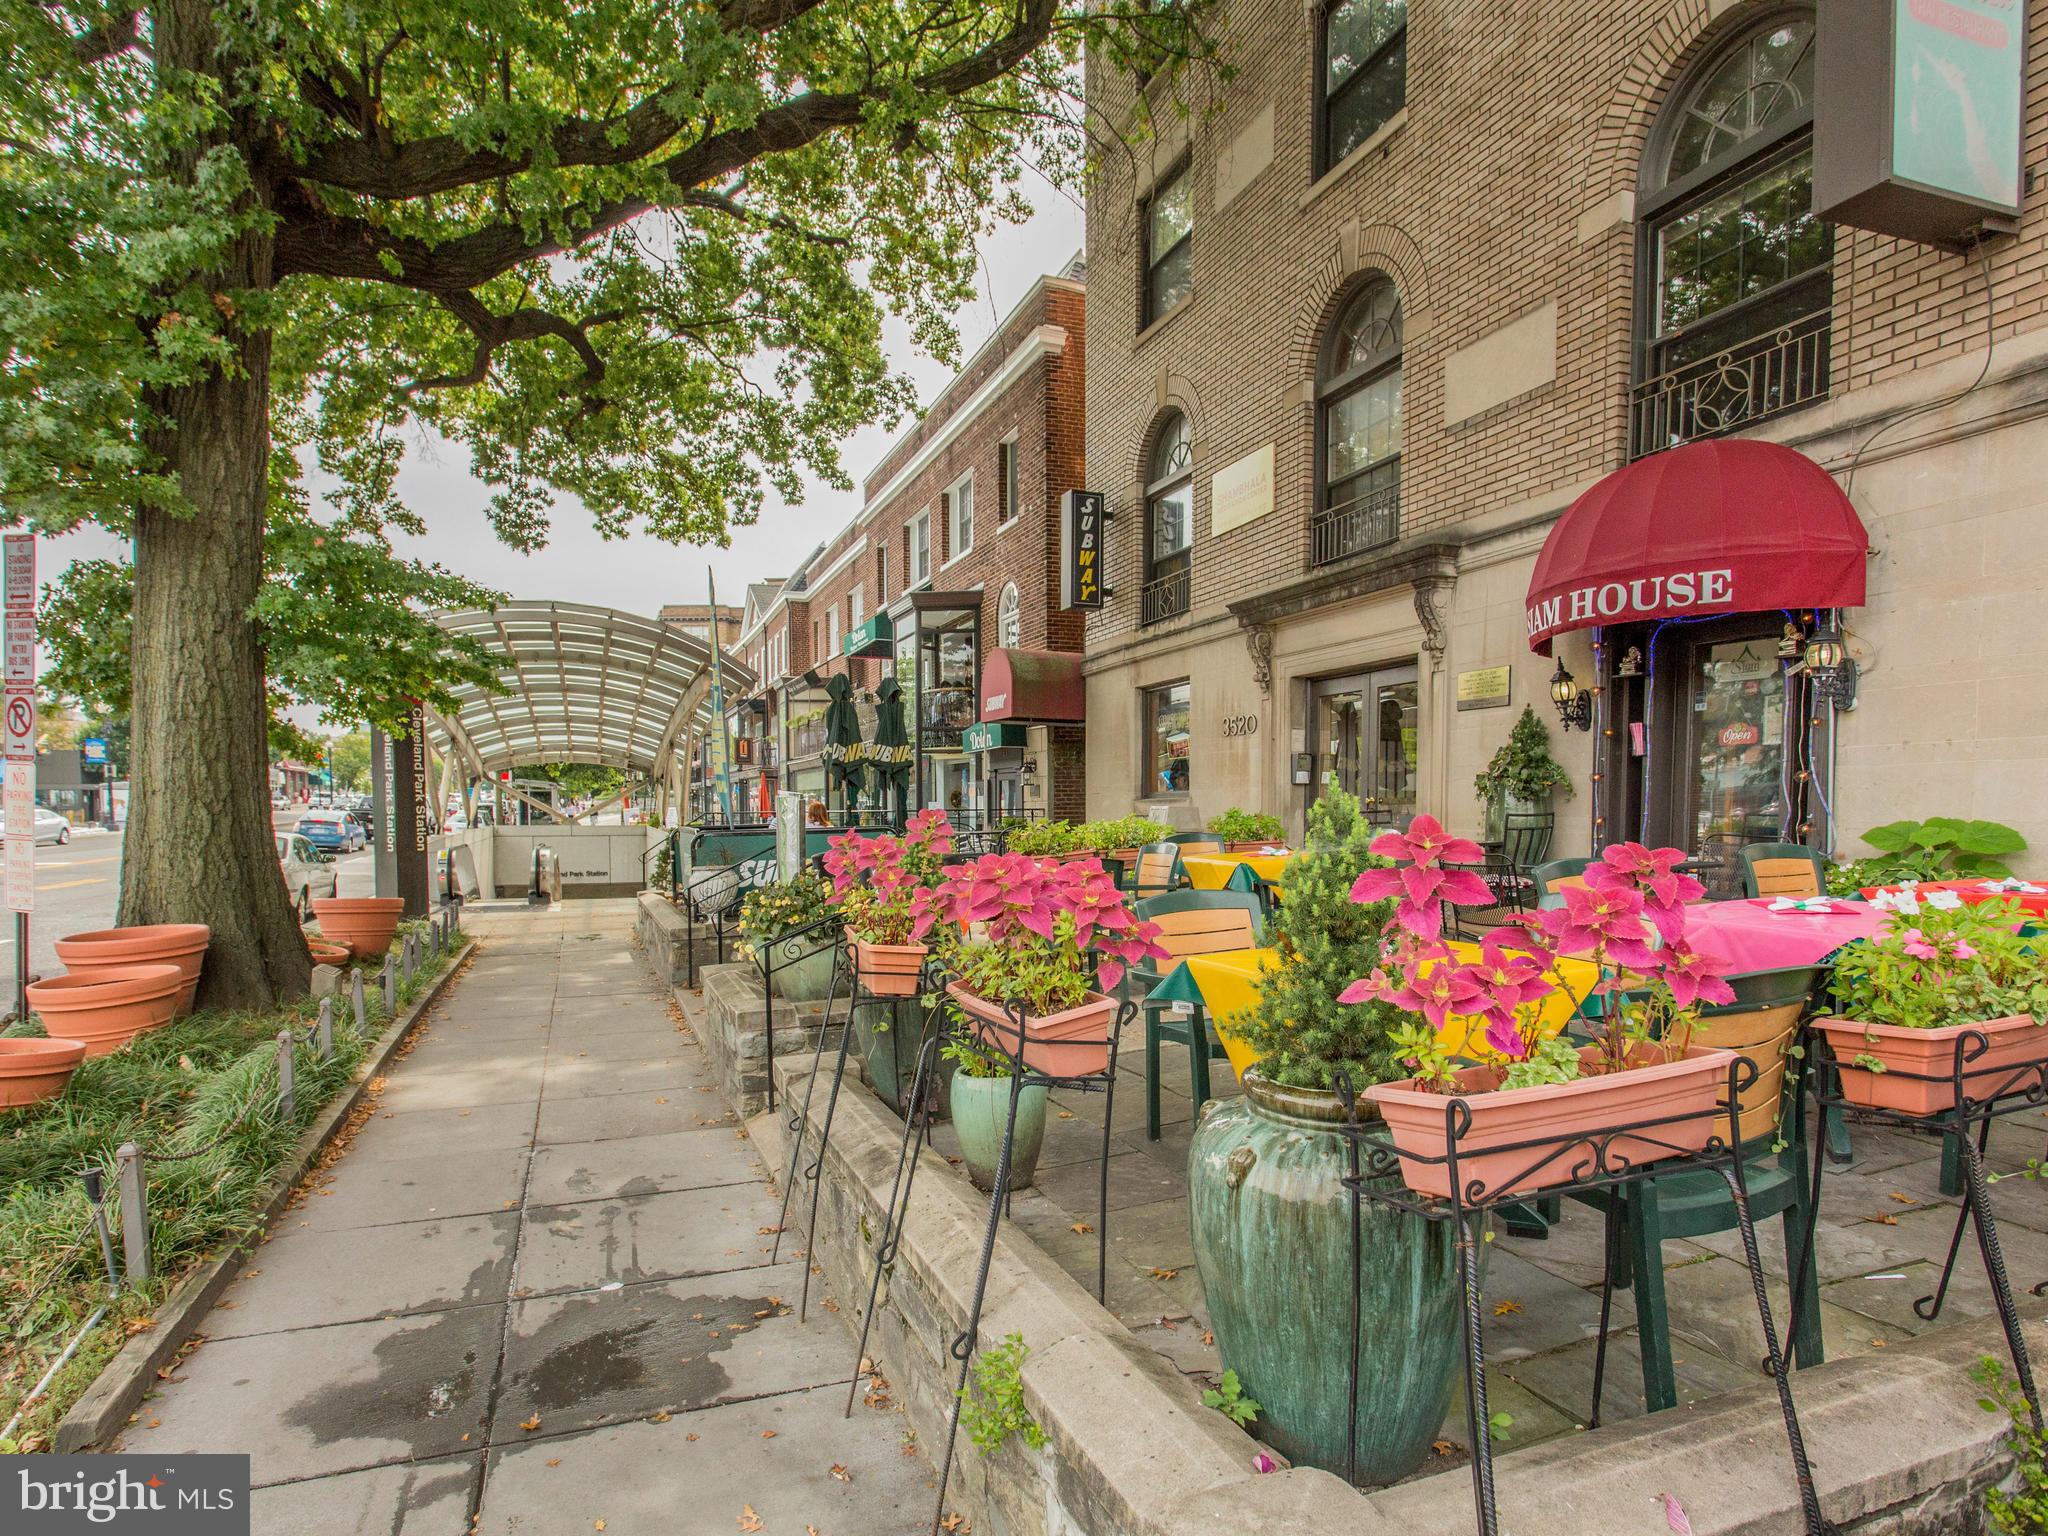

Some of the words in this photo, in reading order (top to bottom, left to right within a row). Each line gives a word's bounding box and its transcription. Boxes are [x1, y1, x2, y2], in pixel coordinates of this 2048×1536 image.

[1079, 498, 1097, 600] SUBWAY
[1528, 596, 1562, 636] SIAM
[1569, 569, 1732, 622] HOUSE
[412, 707, 424, 771] Cleveland
[1223, 714, 1257, 737] 3520
[1723, 729, 1752, 744] Open
[13, 772, 25, 785] NO
[385, 774, 395, 802] Park
[414, 774, 425, 802] Park
[386, 806, 396, 852] Station
[416, 806, 427, 852] Station
